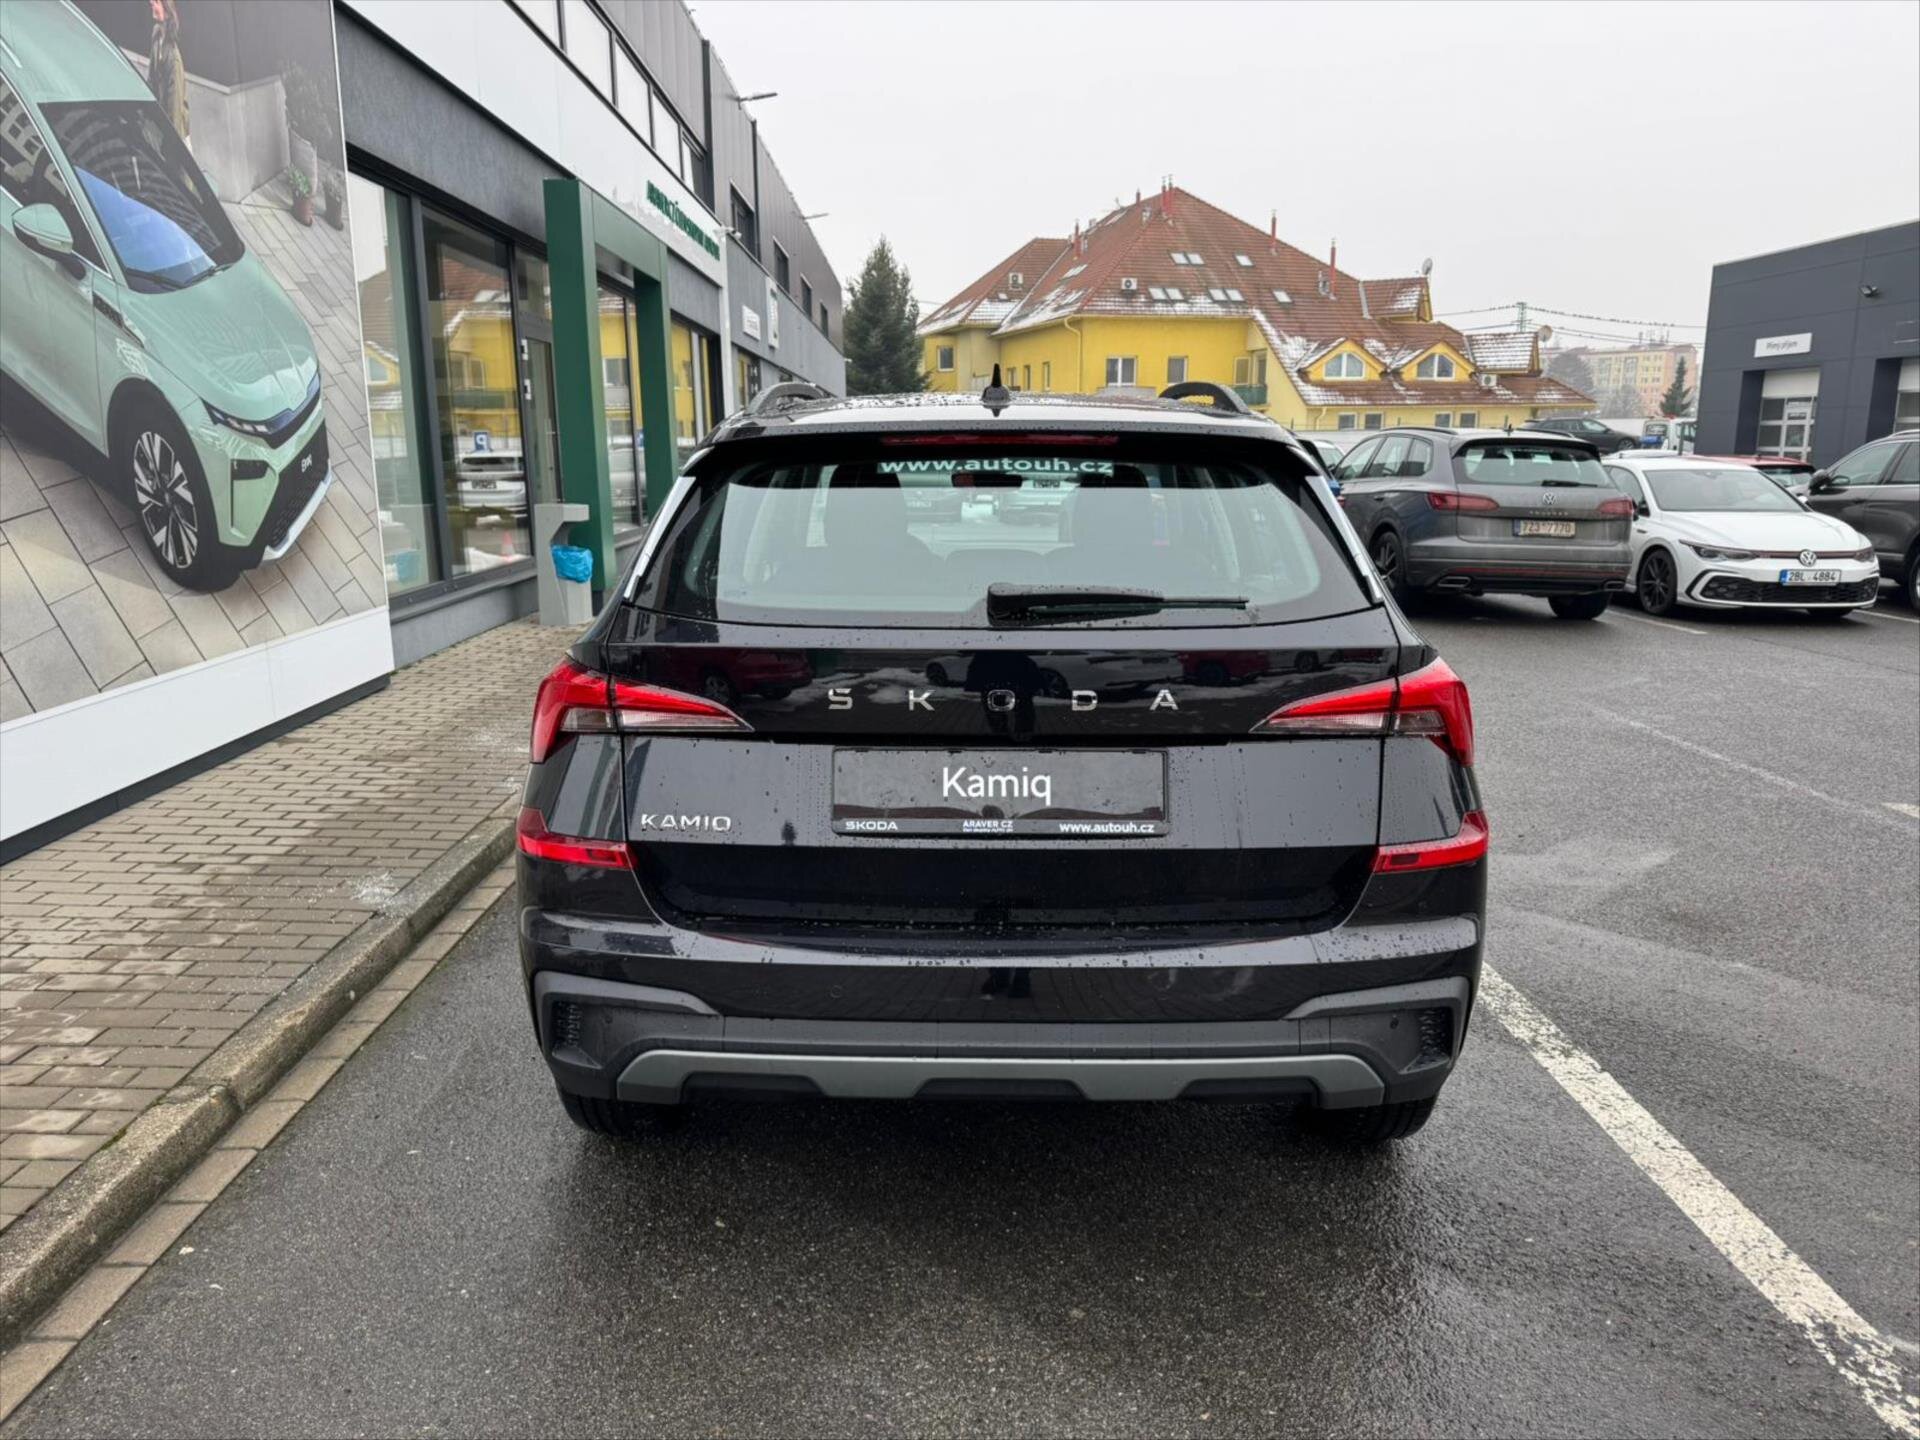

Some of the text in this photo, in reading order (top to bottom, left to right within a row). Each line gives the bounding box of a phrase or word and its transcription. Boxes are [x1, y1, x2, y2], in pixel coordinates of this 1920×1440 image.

[880, 457, 1114, 474] www.autouh.cz
[942, 766, 1051, 806] Kamiq
[845, 821, 898, 831] SKODA
[963, 819, 1014, 828] ARAVER CZ
[1059, 822, 1155, 833] www.autouh.cz
